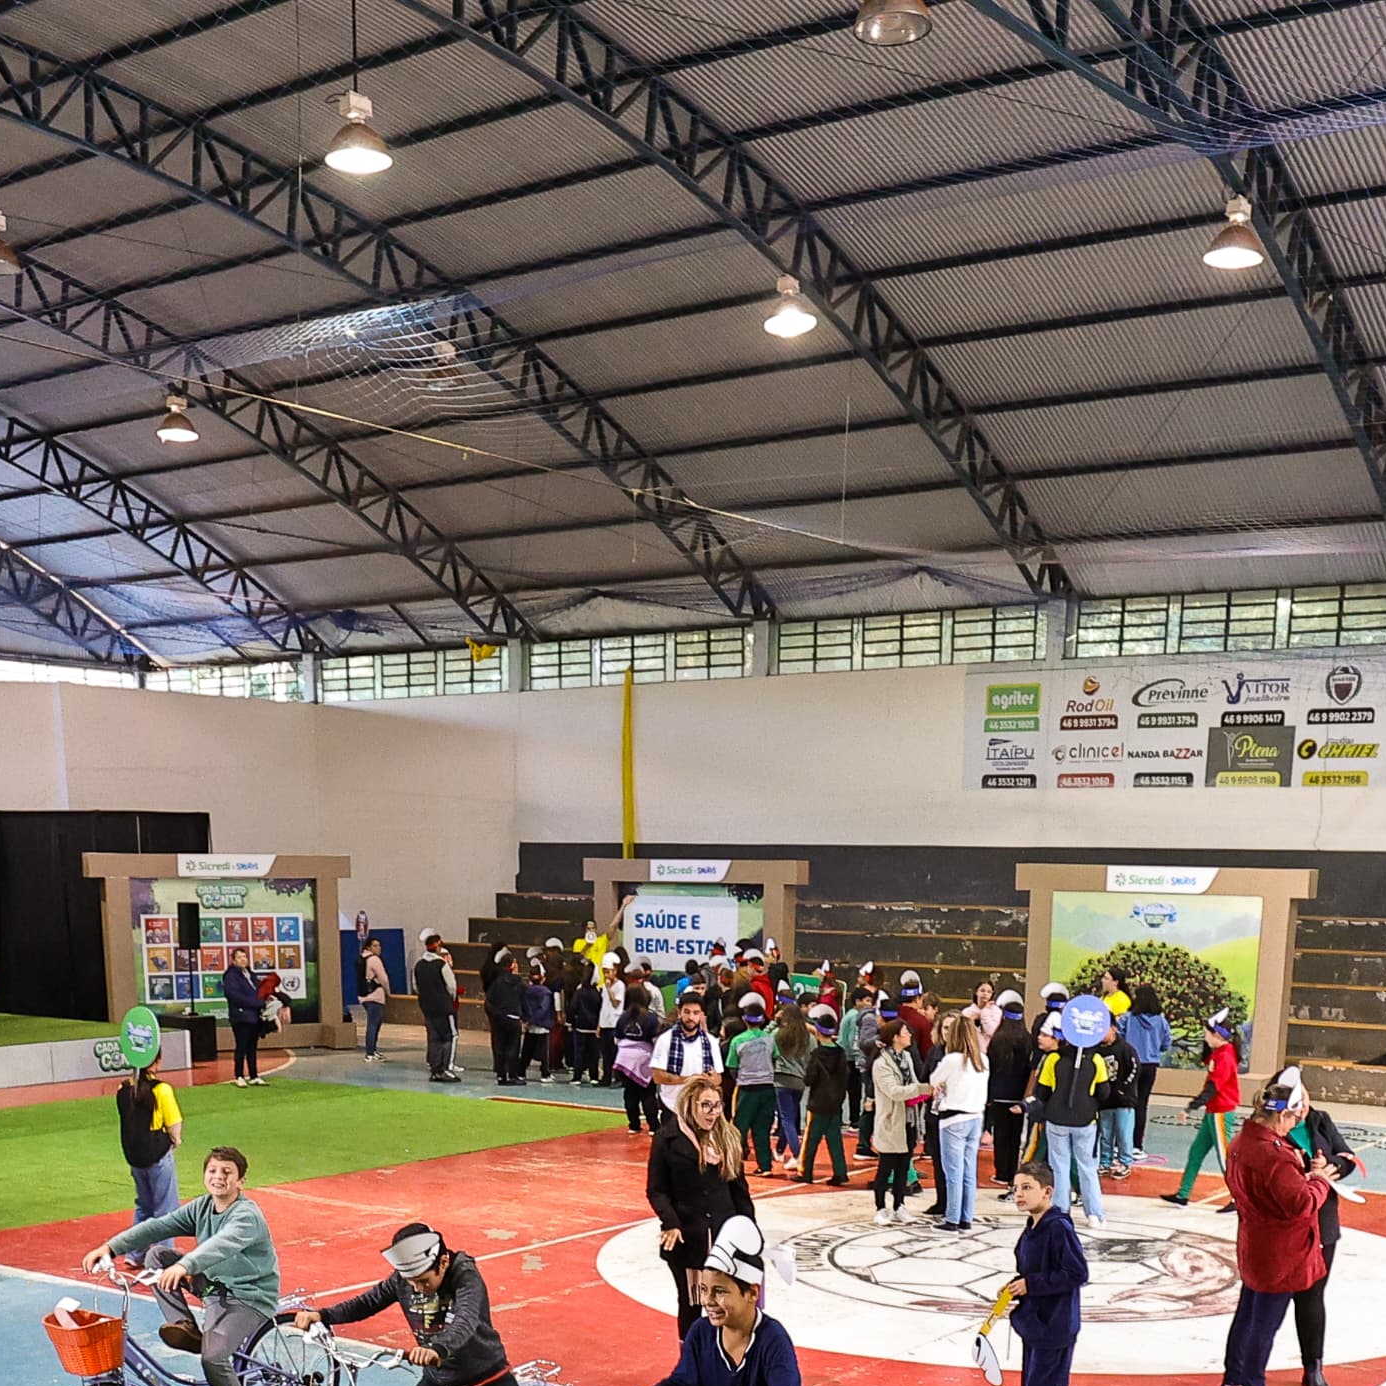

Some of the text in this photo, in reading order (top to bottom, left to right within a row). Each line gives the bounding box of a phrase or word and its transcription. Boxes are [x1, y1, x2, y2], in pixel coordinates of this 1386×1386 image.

[1147, 687, 1209, 700] Previnne
[1223, 714, 1235, 724] 46
[1309, 711, 1321, 722] 46
[1322, 711, 1328, 722] 9
[1069, 742, 1124, 759] clinicel
[1128, 748, 1204, 759] NANDA BAZZAR
[635, 908, 701, 930] SAÚDE E
[635, 937, 714, 955] BEM-ESTA
